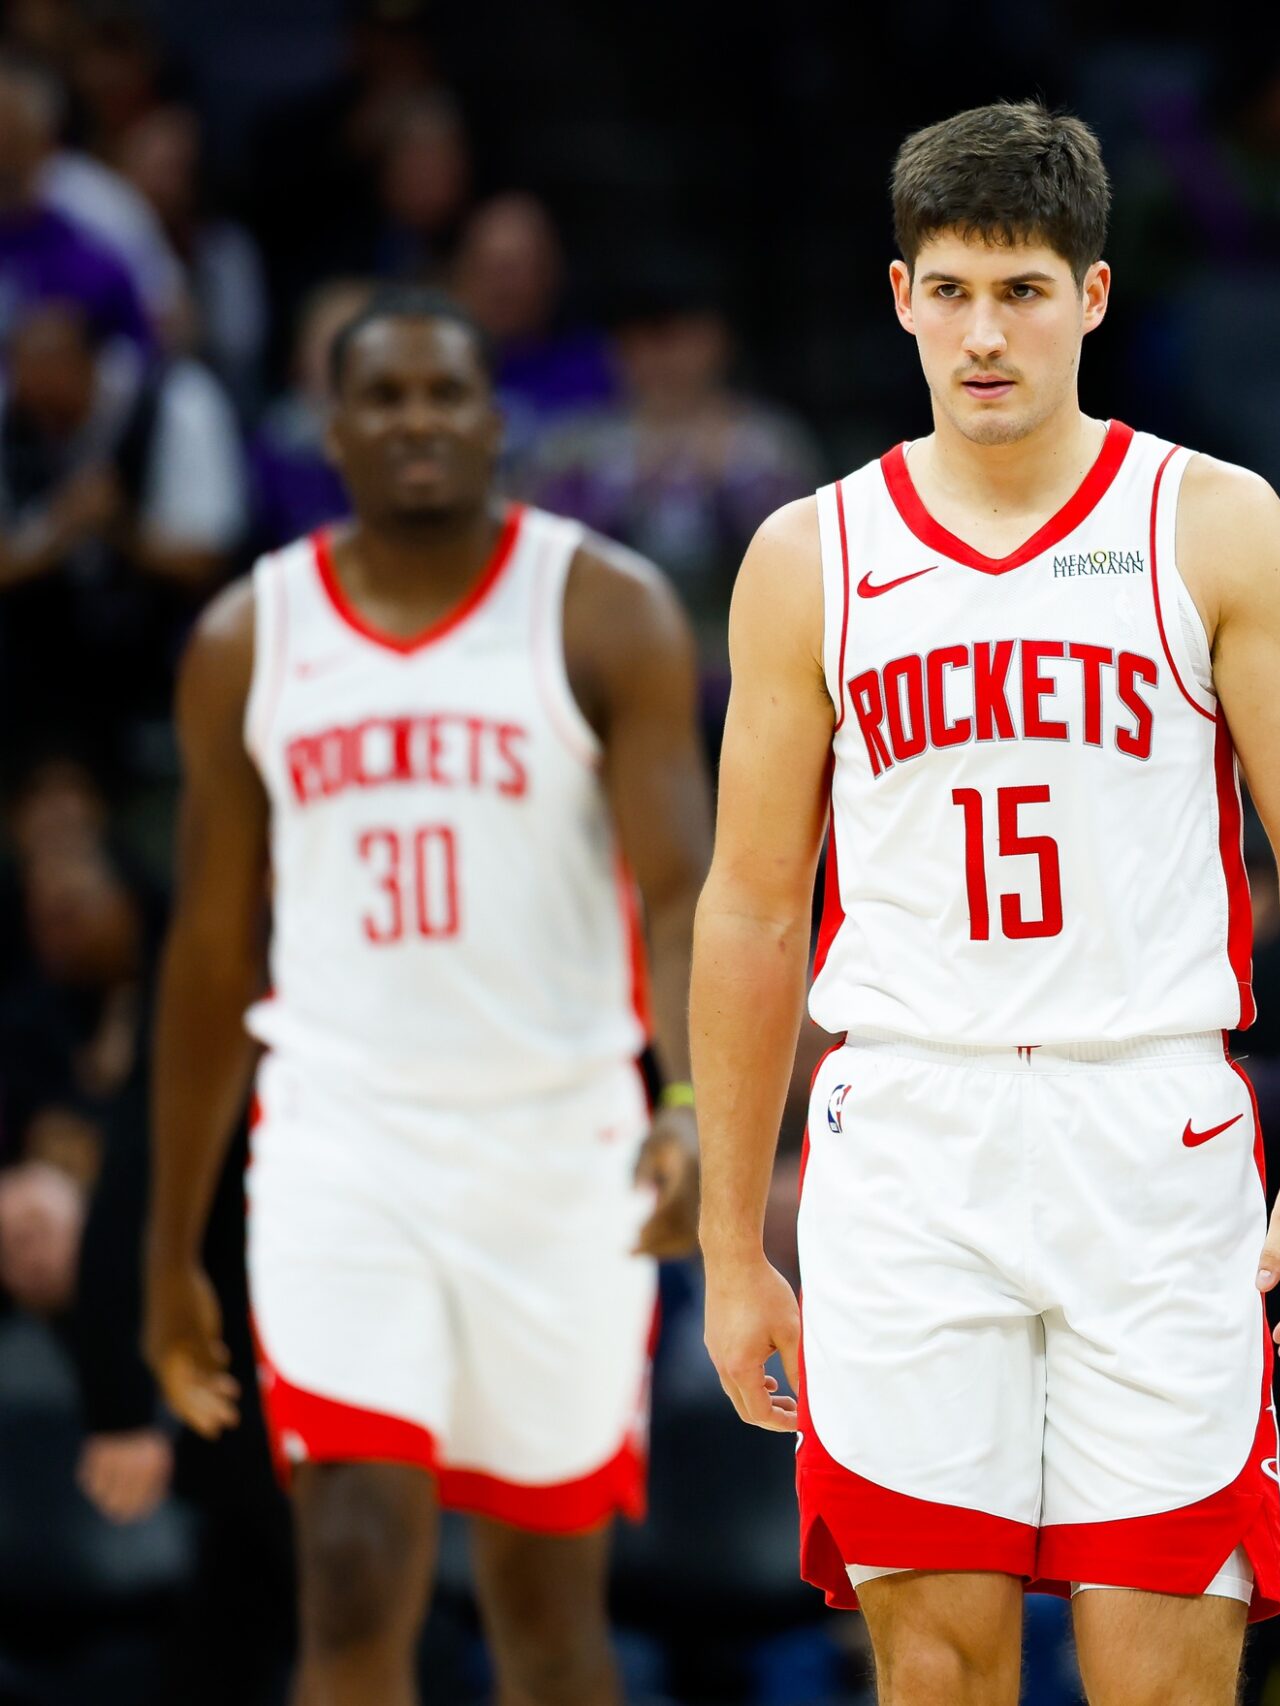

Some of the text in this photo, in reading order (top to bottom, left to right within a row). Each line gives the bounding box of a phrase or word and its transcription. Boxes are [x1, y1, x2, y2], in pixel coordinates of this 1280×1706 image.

[1053, 550, 1144, 567] MEMORIAL
[1053, 560, 1144, 578] HERMANN
[286, 713, 529, 808] ROCKETS
[848, 639, 1159, 780] ROCKETS
[357, 822, 460, 944] 30
[951, 784, 1064, 941] 15
